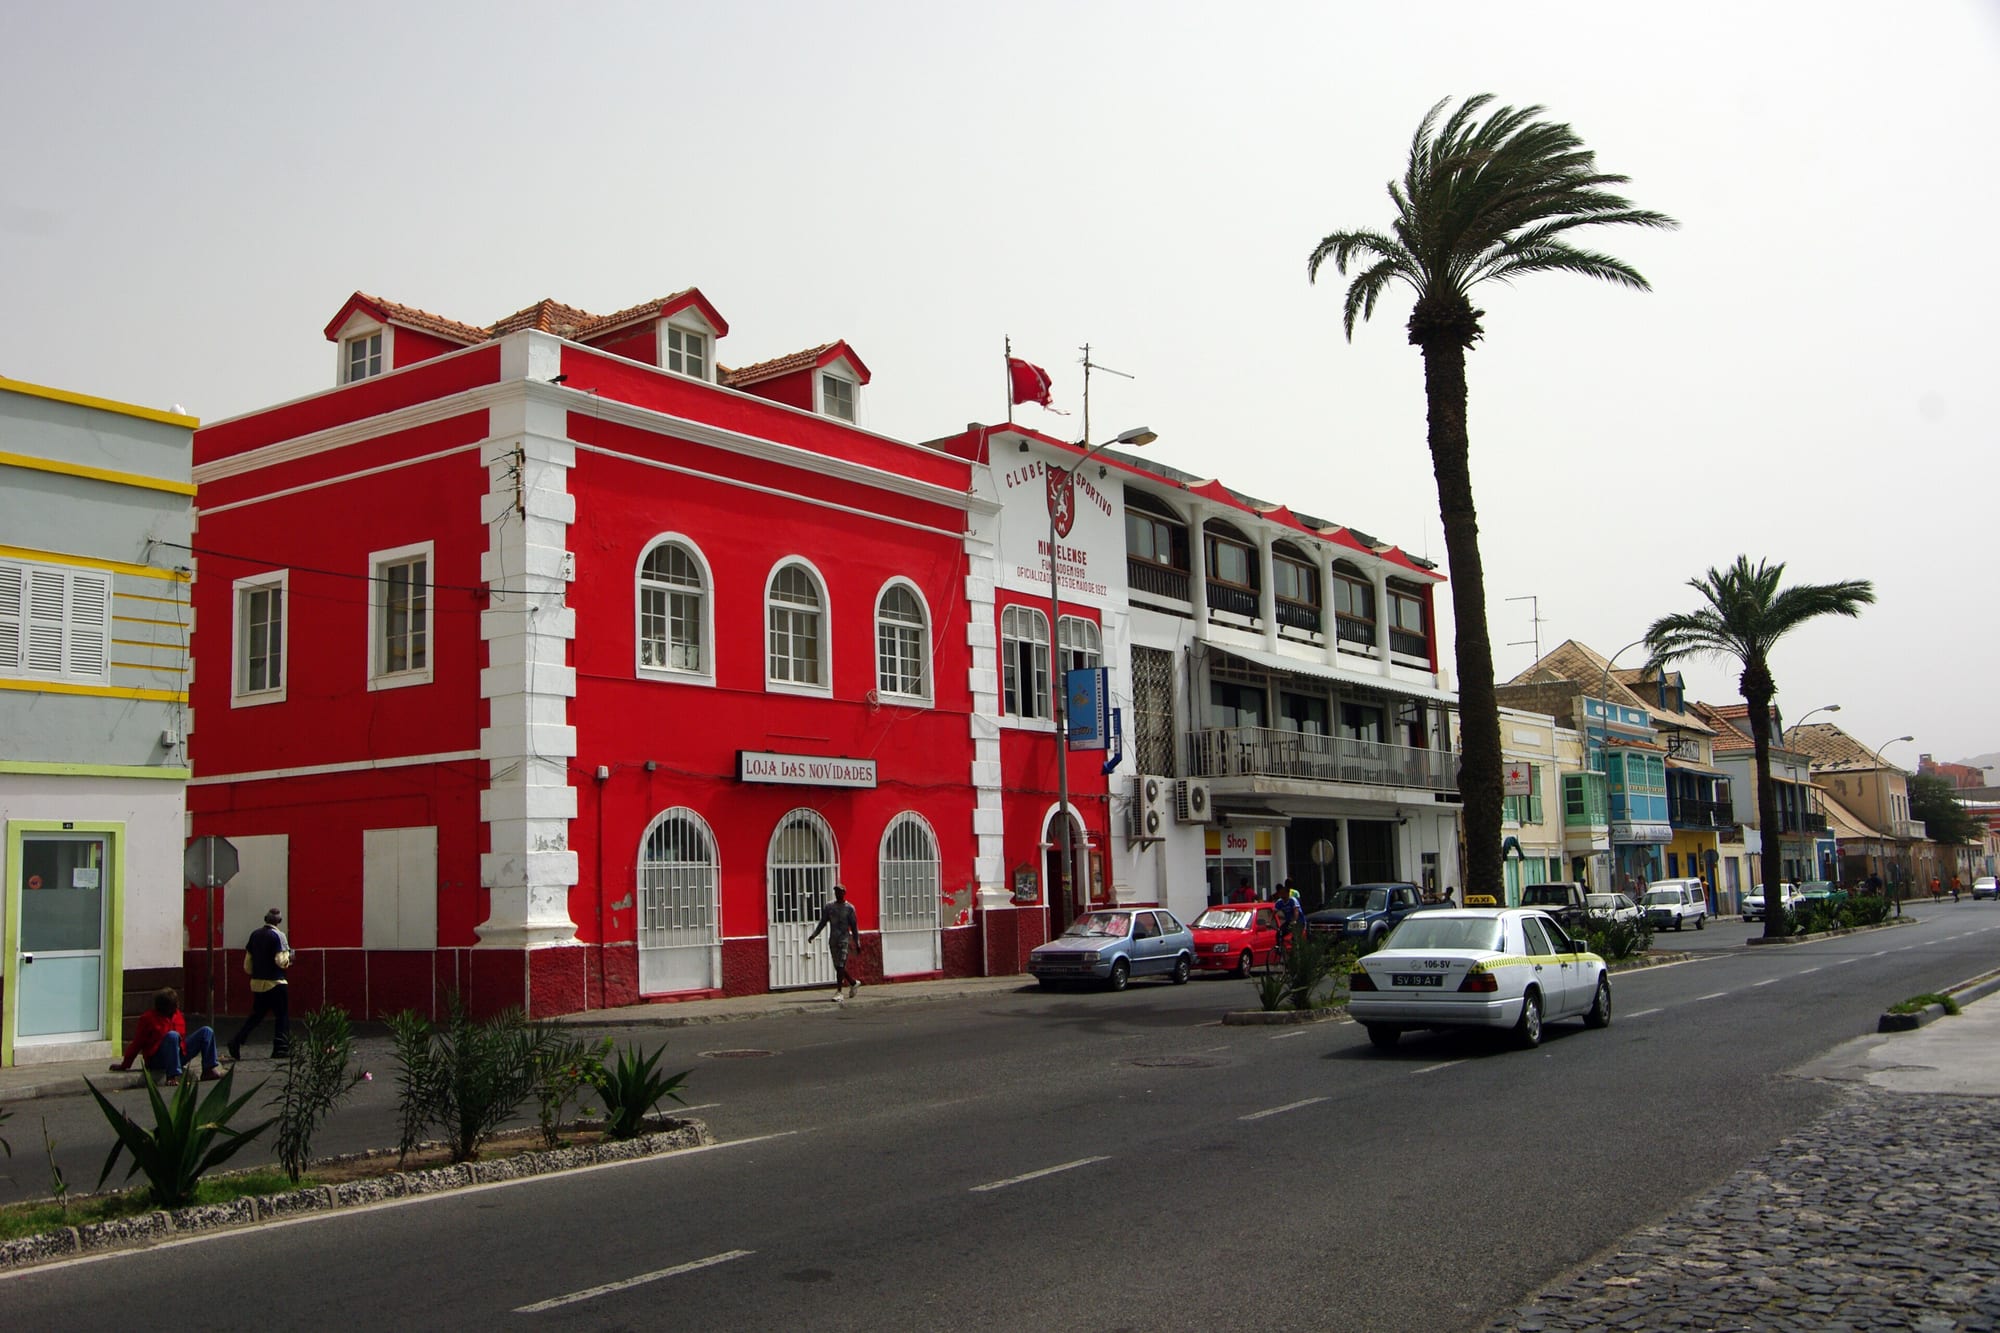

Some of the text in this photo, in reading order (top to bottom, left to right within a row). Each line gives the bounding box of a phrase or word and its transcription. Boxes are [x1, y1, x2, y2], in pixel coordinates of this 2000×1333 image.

[1006, 461, 1112, 517] CLUBE SPORTIVO
[1038, 540, 1087, 566] MINELENSE
[1041, 559, 1066, 575] FUNADO
[746, 759, 873, 781] LOJA DAS NOVIDADES
[1227, 833, 1248, 852] Shop
